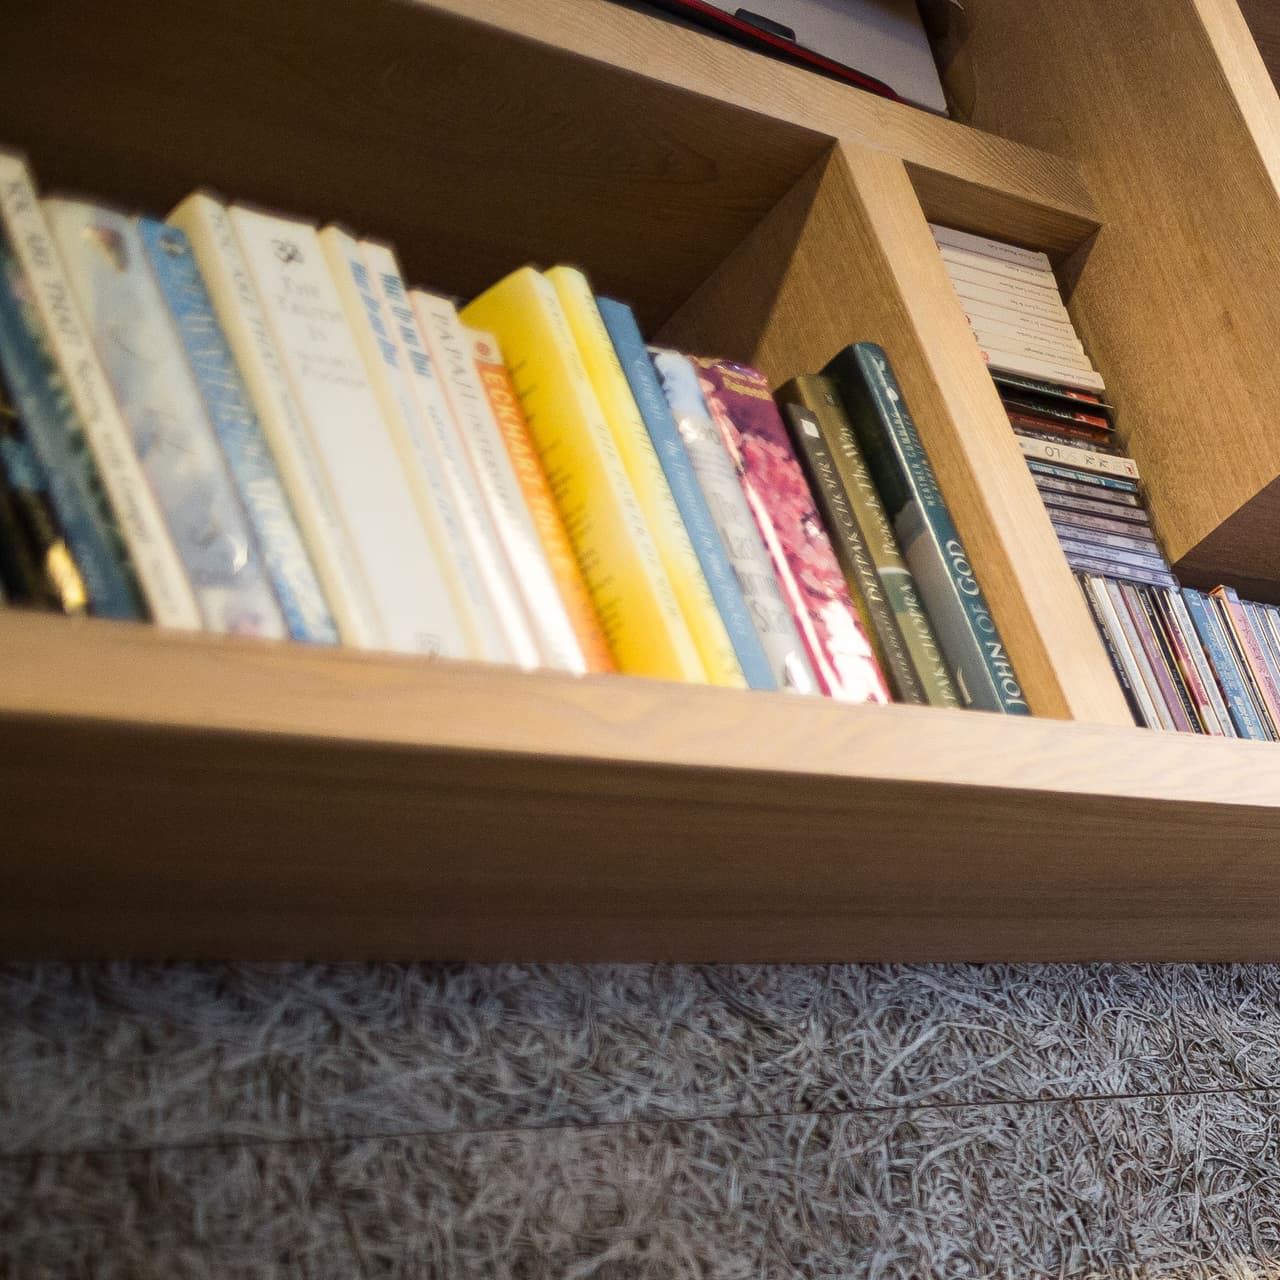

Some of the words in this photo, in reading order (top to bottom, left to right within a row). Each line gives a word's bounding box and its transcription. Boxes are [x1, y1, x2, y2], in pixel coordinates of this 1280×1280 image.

[483, 374, 542, 496] ECKHART
[851, 459, 873, 490] The
[911, 463, 937, 507] HEATHER
[847, 531, 885, 602] DEEPAK
[946, 539, 981, 597] GOD
[900, 584, 941, 664] CHOPRA
[969, 602, 996, 634] OF
[984, 641, 1026, 706] JOHN
